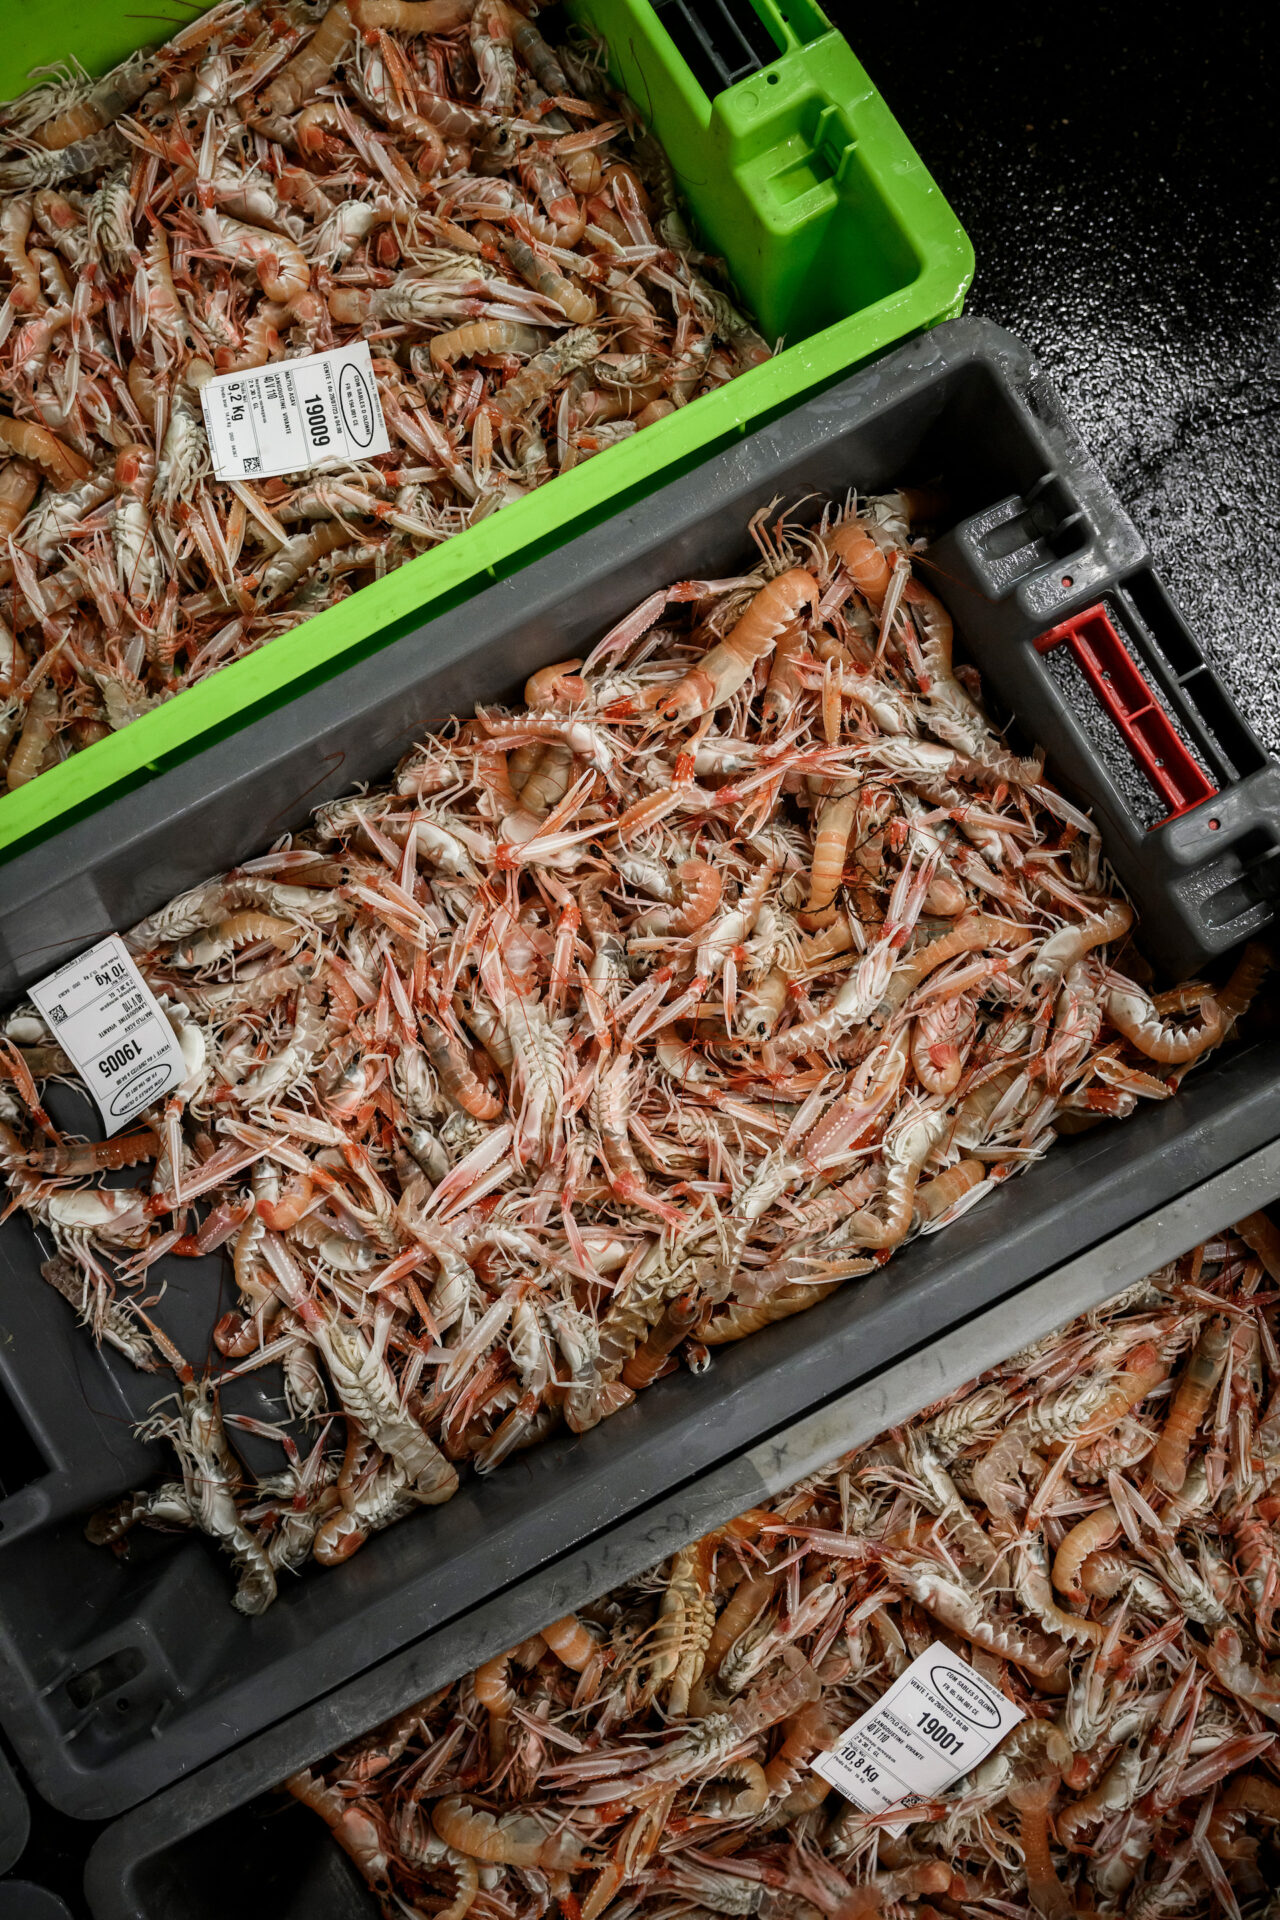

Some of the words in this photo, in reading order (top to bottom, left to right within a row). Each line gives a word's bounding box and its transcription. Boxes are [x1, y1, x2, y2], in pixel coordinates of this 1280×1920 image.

[322, 362, 330, 380] VENTE
[226, 383, 242, 402] 9,2
[229, 404, 246, 421] Kg
[274, 373, 286, 409] LANGOUSTINE
[282, 412, 291, 434] VIVANTE
[303, 393, 330, 447] 19009
[93, 969, 112, 988] Kg
[110, 961, 126, 978] 10
[117, 1001, 147, 1025] LANGOUSTINE
[96, 1037, 143, 1078] 19005
[155, 1043, 170, 1056] VENTE
[909, 1679, 926, 1694] VENTE
[956, 1679, 975, 1697] SABLES
[977, 1697, 997, 1716] OLONNE
[970, 1707, 979, 1716] CE
[873, 1717, 904, 1745] LANGOUSTINE
[904, 1743, 925, 1761] VIVANTE
[912, 1709, 965, 1756] 19001
[837, 1744, 866, 1770] 10,8
[860, 1763, 881, 1783] Kg
